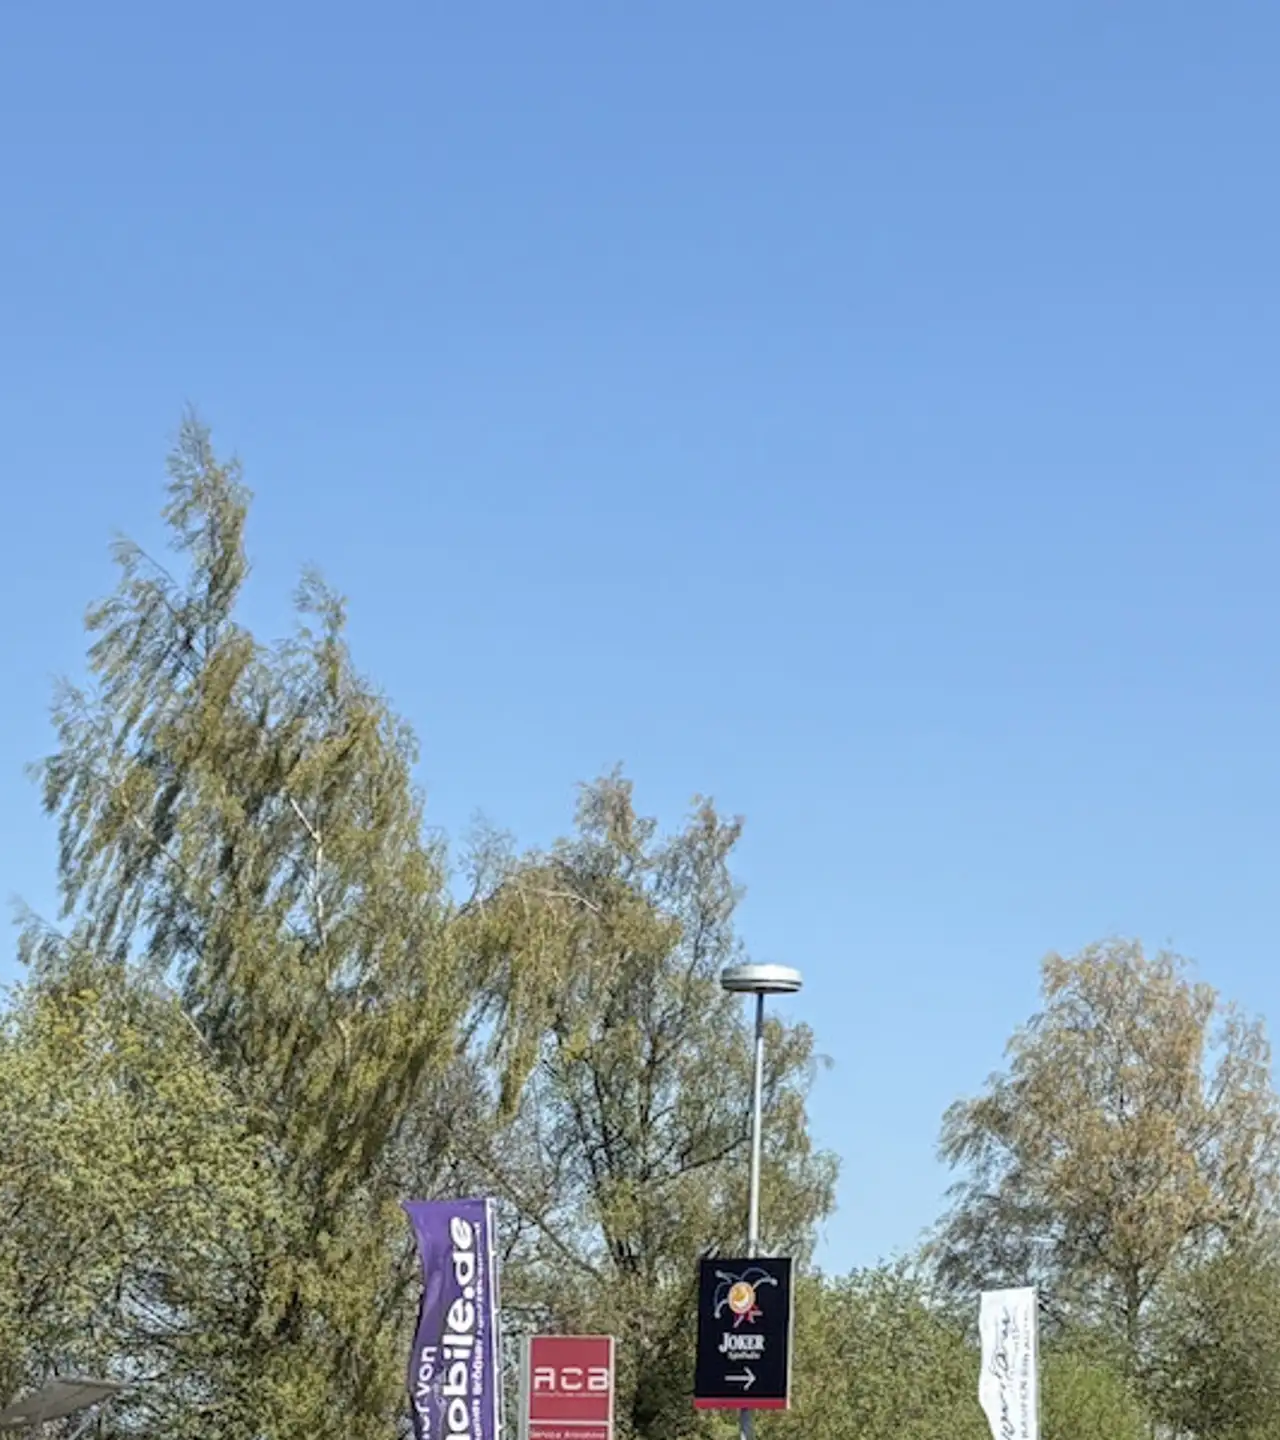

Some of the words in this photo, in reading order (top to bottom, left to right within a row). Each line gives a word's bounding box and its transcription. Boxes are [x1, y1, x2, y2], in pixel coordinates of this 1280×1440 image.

[719, 1332, 765, 1353] JOKER
[416, 1346, 438, 1397] von
[533, 1366, 609, 1391] ACB
